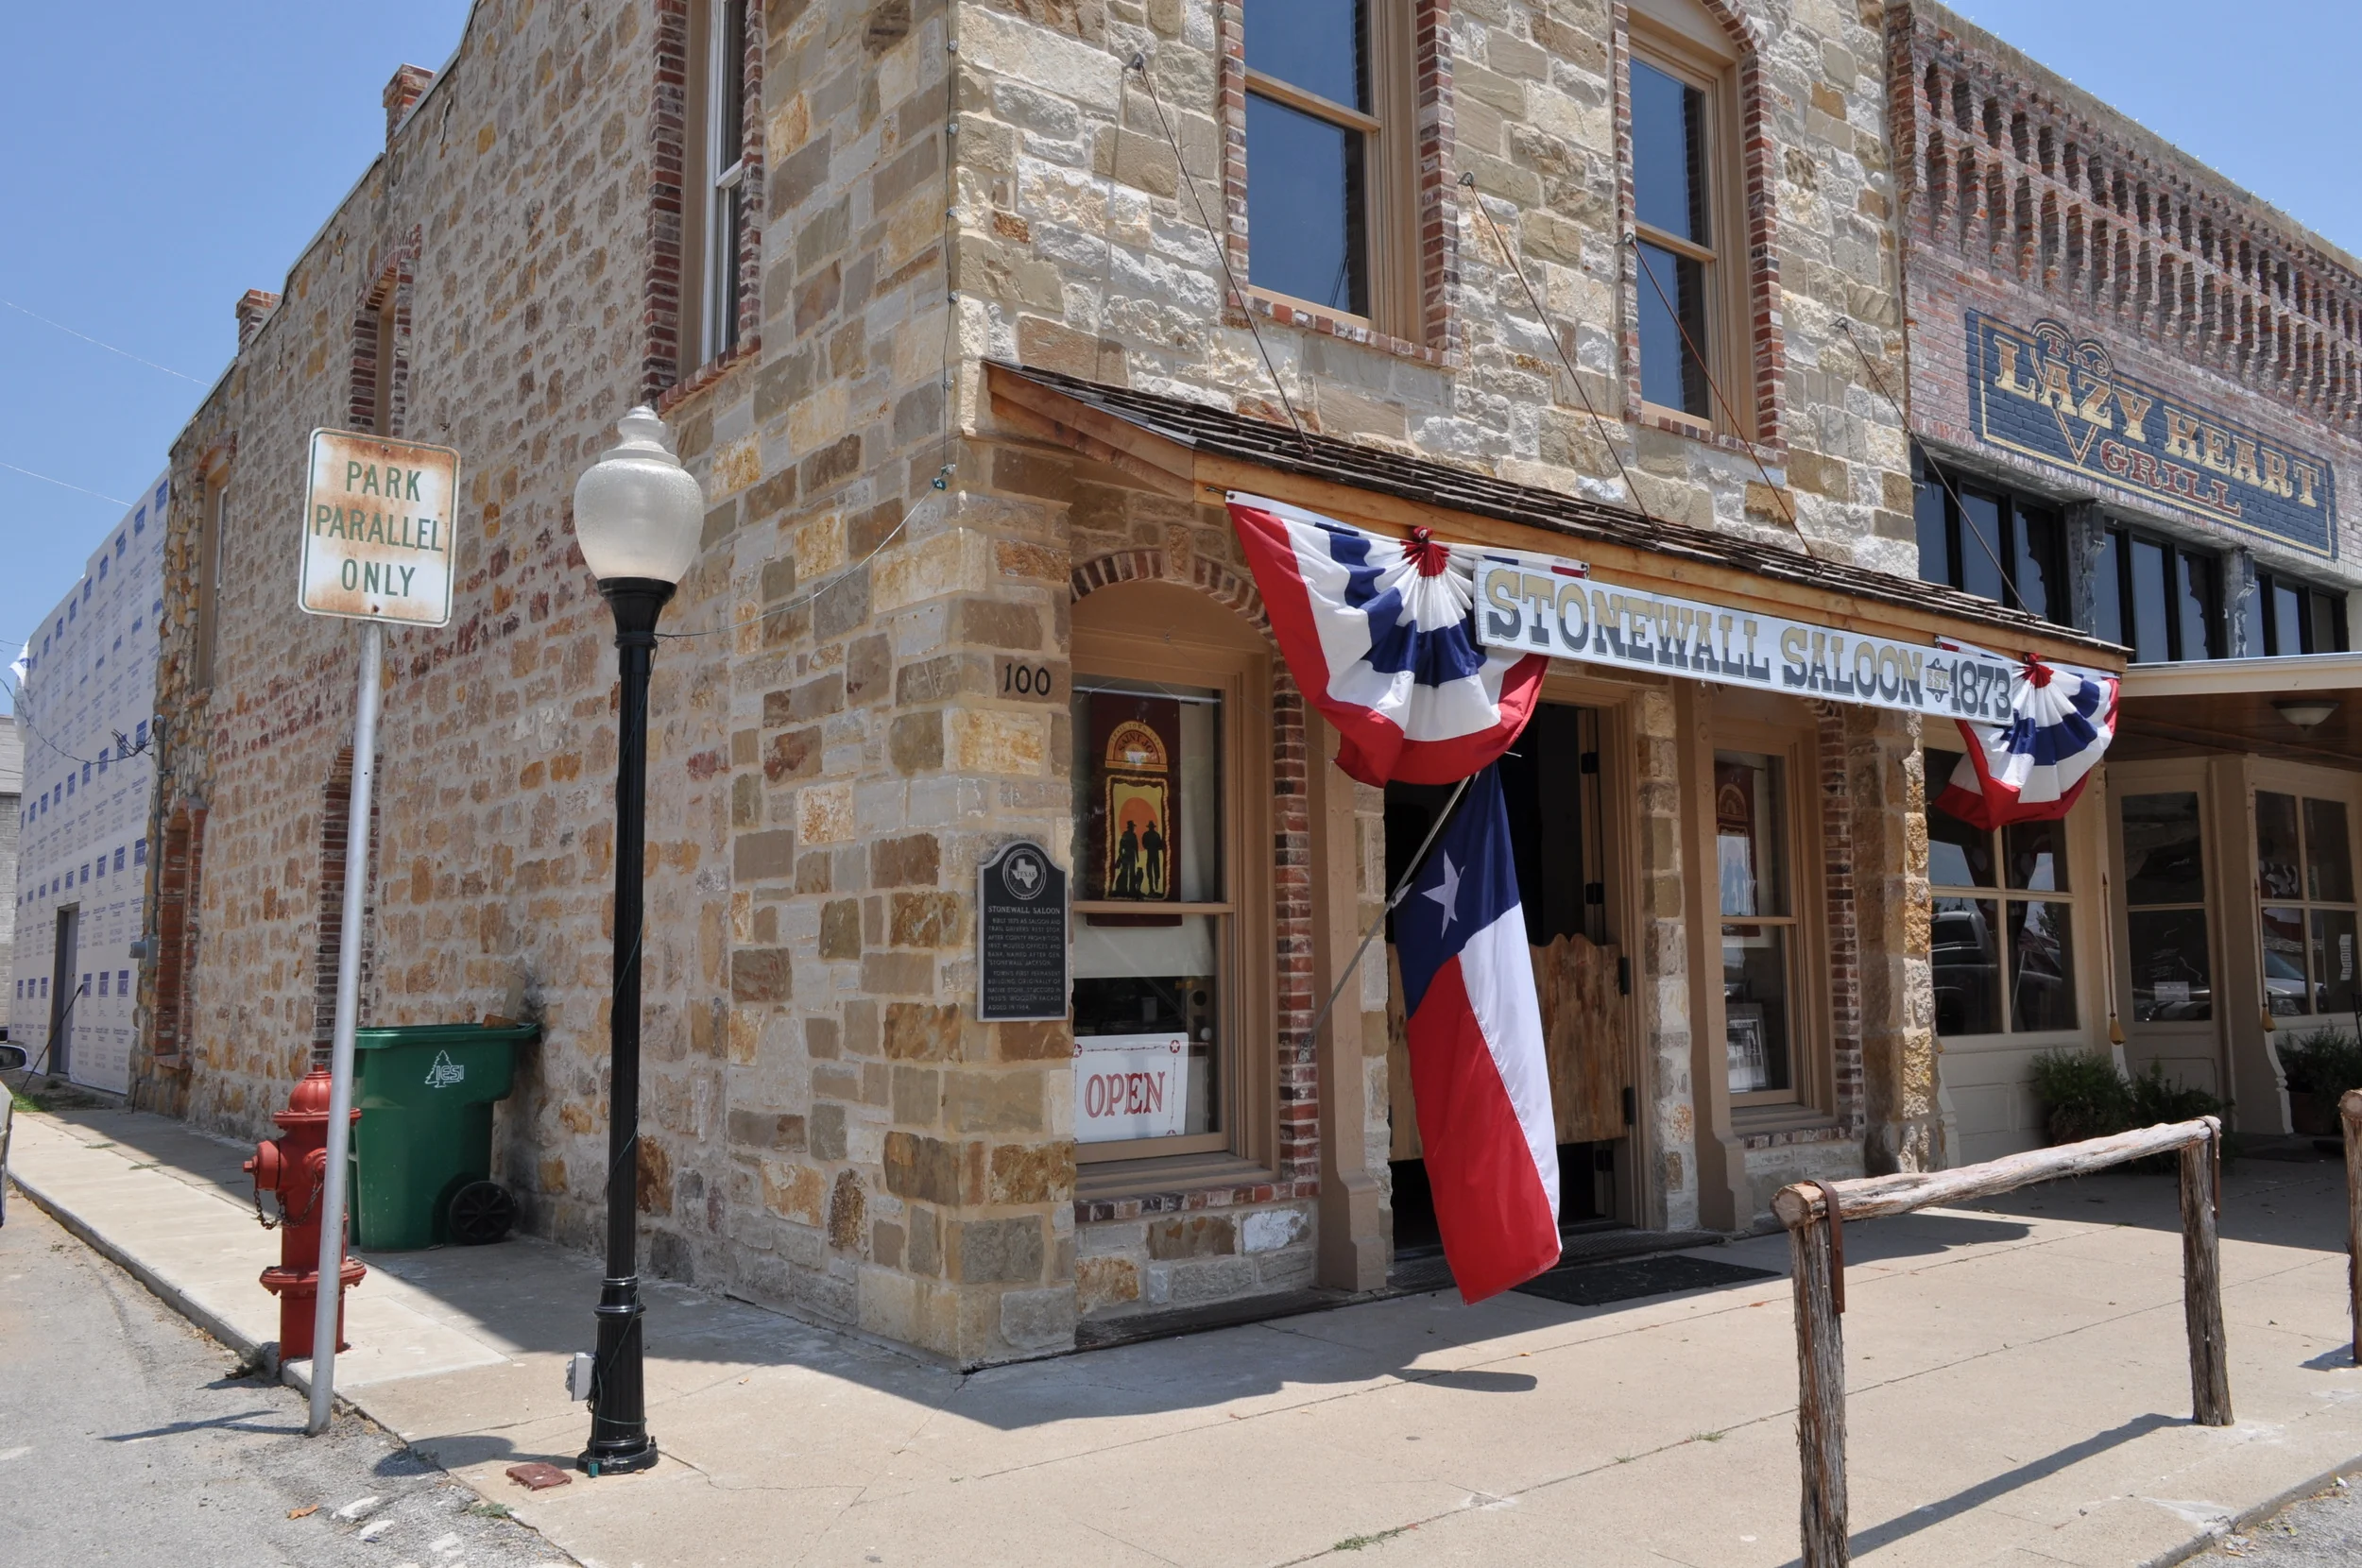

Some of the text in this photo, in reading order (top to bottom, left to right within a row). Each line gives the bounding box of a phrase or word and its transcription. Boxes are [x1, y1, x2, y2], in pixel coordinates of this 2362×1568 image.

[2042, 332, 2111, 377] The
[1993, 334, 2319, 508] LAZY HEART
[346, 460, 421, 503] PARK
[2099, 439, 2242, 518] GRILL
[315, 504, 444, 553] PARALLEL
[341, 557, 417, 598] ONLY
[1485, 567, 2011, 720] STONEWALL SALOON EST 1873
[1004, 663, 1052, 697] 100
[1118, 732, 1154, 753] SAINT JO
[987, 905, 1030, 913] STONEWALL
[436, 1065, 465, 1082] IESI
[1085, 1070, 1166, 1119] OPEN
